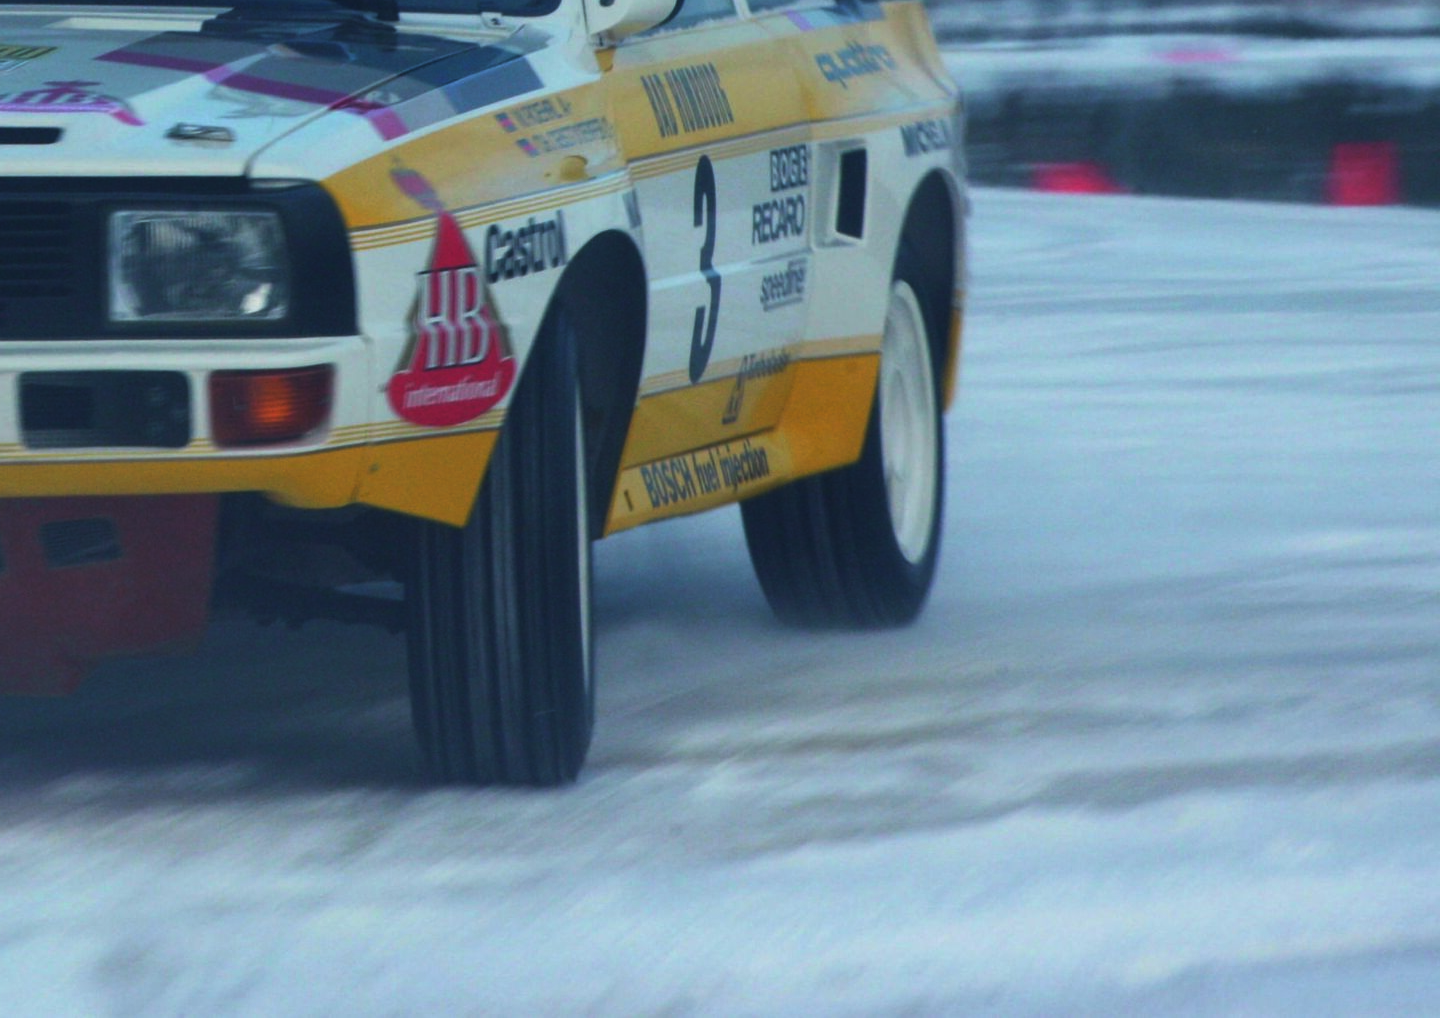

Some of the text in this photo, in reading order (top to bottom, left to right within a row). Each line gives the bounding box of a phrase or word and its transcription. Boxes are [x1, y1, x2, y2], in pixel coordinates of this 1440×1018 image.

[484, 210, 566, 284] Castrol
[752, 194, 805, 246] RECARO
[689, 155, 722, 383] 3
[420, 268, 490, 372] HB
[641, 455, 697, 508] BOSCH
